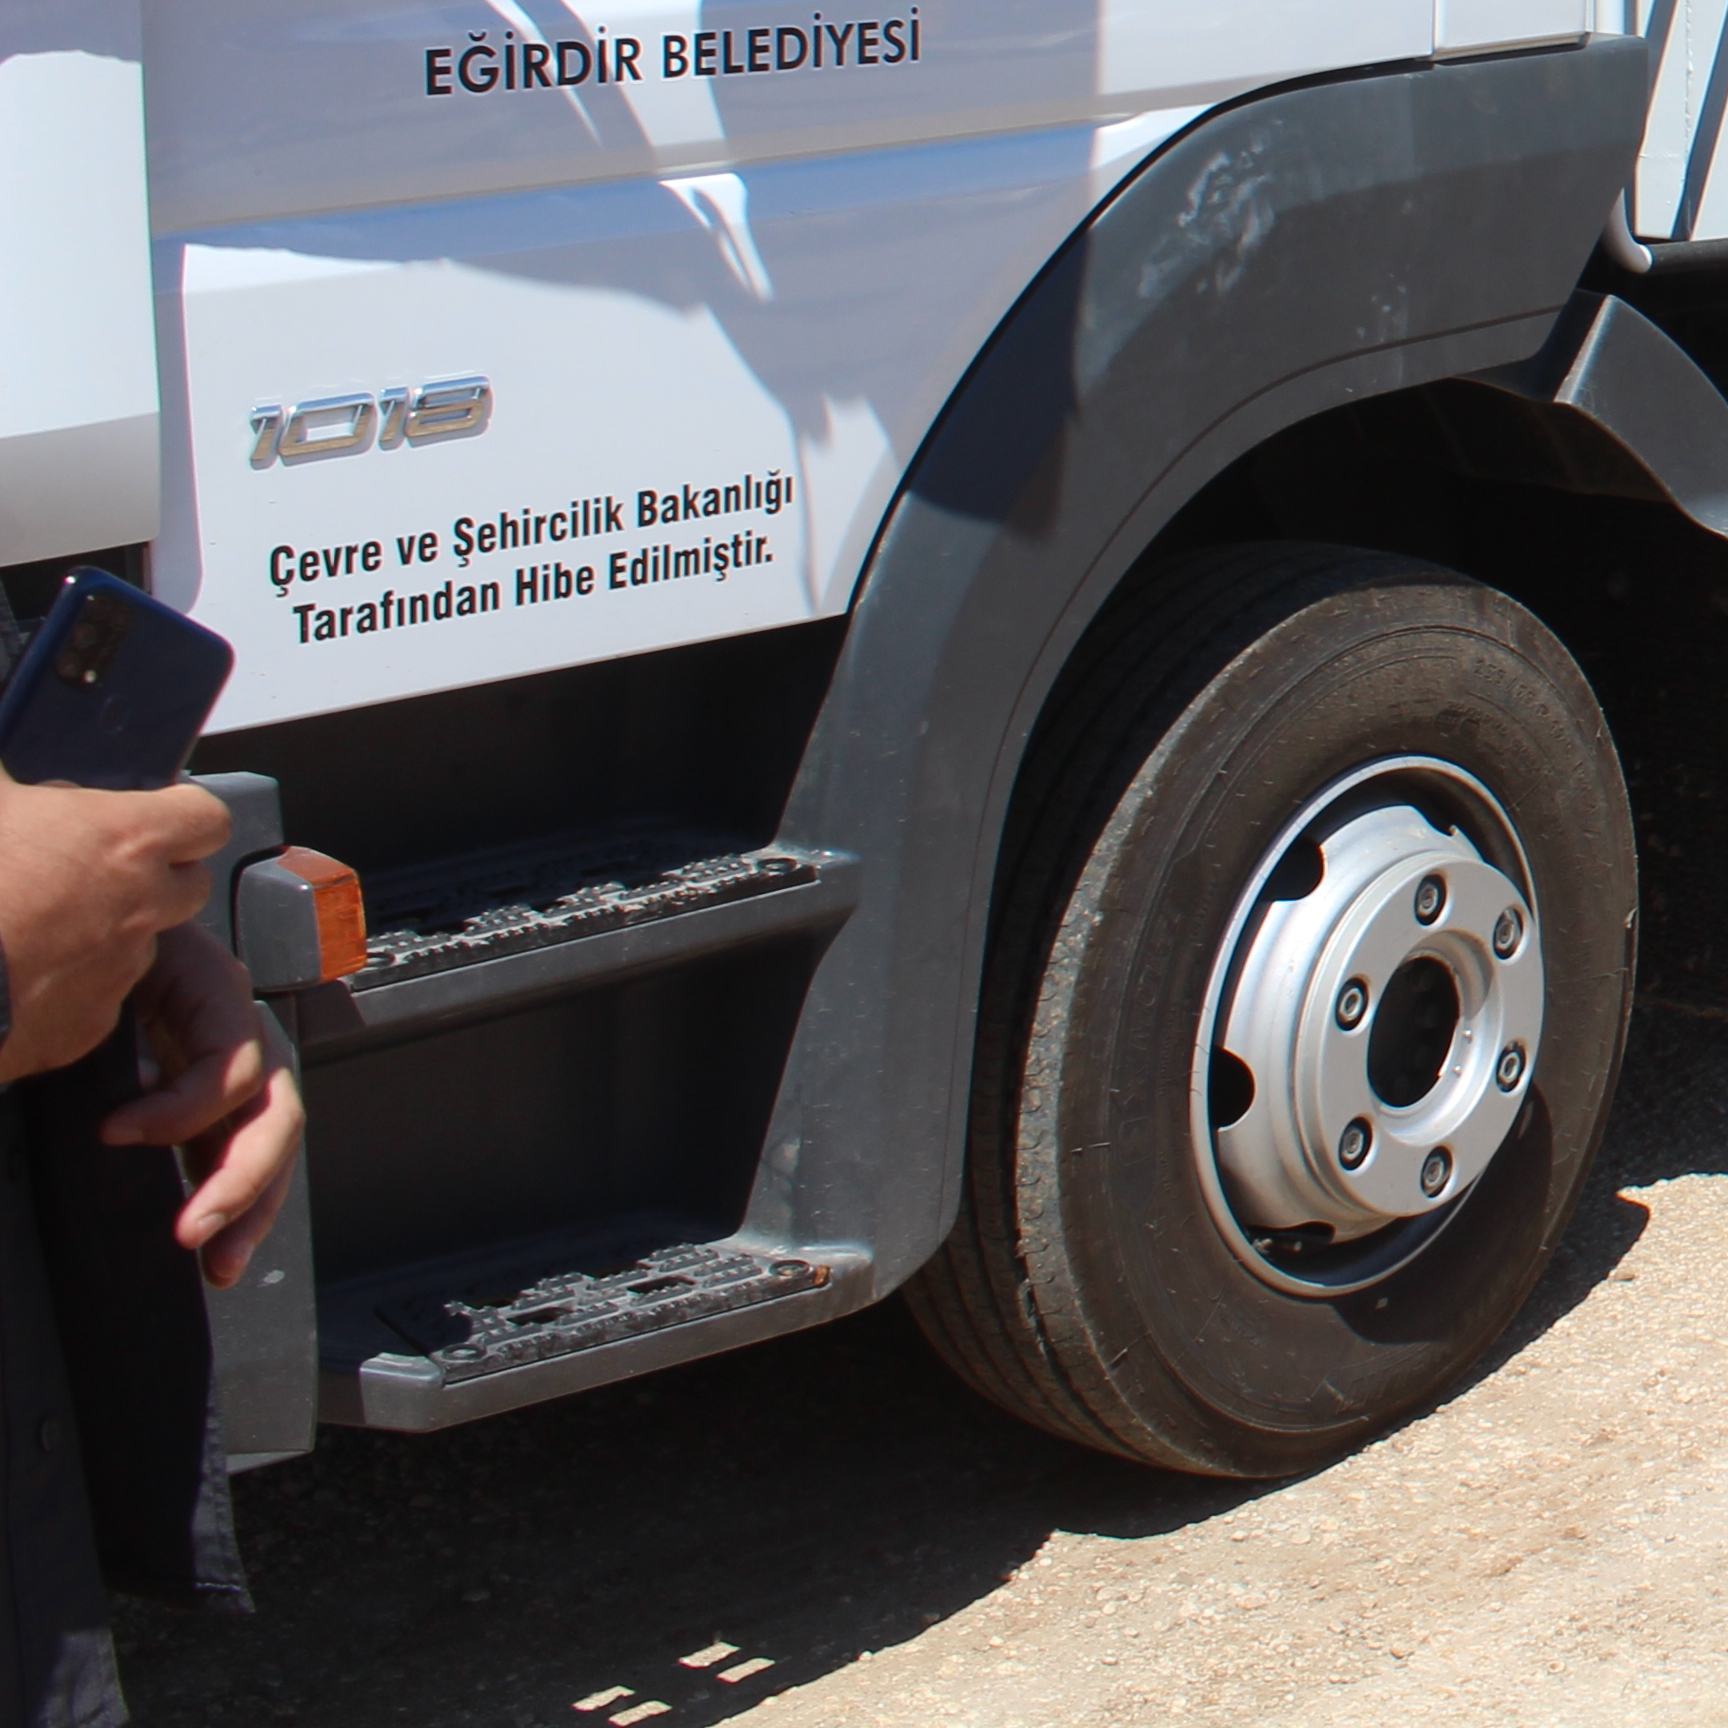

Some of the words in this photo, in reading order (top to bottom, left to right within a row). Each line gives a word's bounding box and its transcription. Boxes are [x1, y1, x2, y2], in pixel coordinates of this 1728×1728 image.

[425, 25, 643, 96] EĞİRDİR
[662, 6, 921, 79] BELEDİYESİ
[250, 375, 490, 465] 1018
[270, 539, 383, 598] Çevre
[396, 532, 439, 566] ve
[453, 495, 625, 568] Şehircilik
[637, 468, 794, 528] Bakanlığı
[292, 579, 501, 645] Tarafından
[515, 562, 595, 606] Hibe
[608, 529, 774, 591] Edilmiştir.
